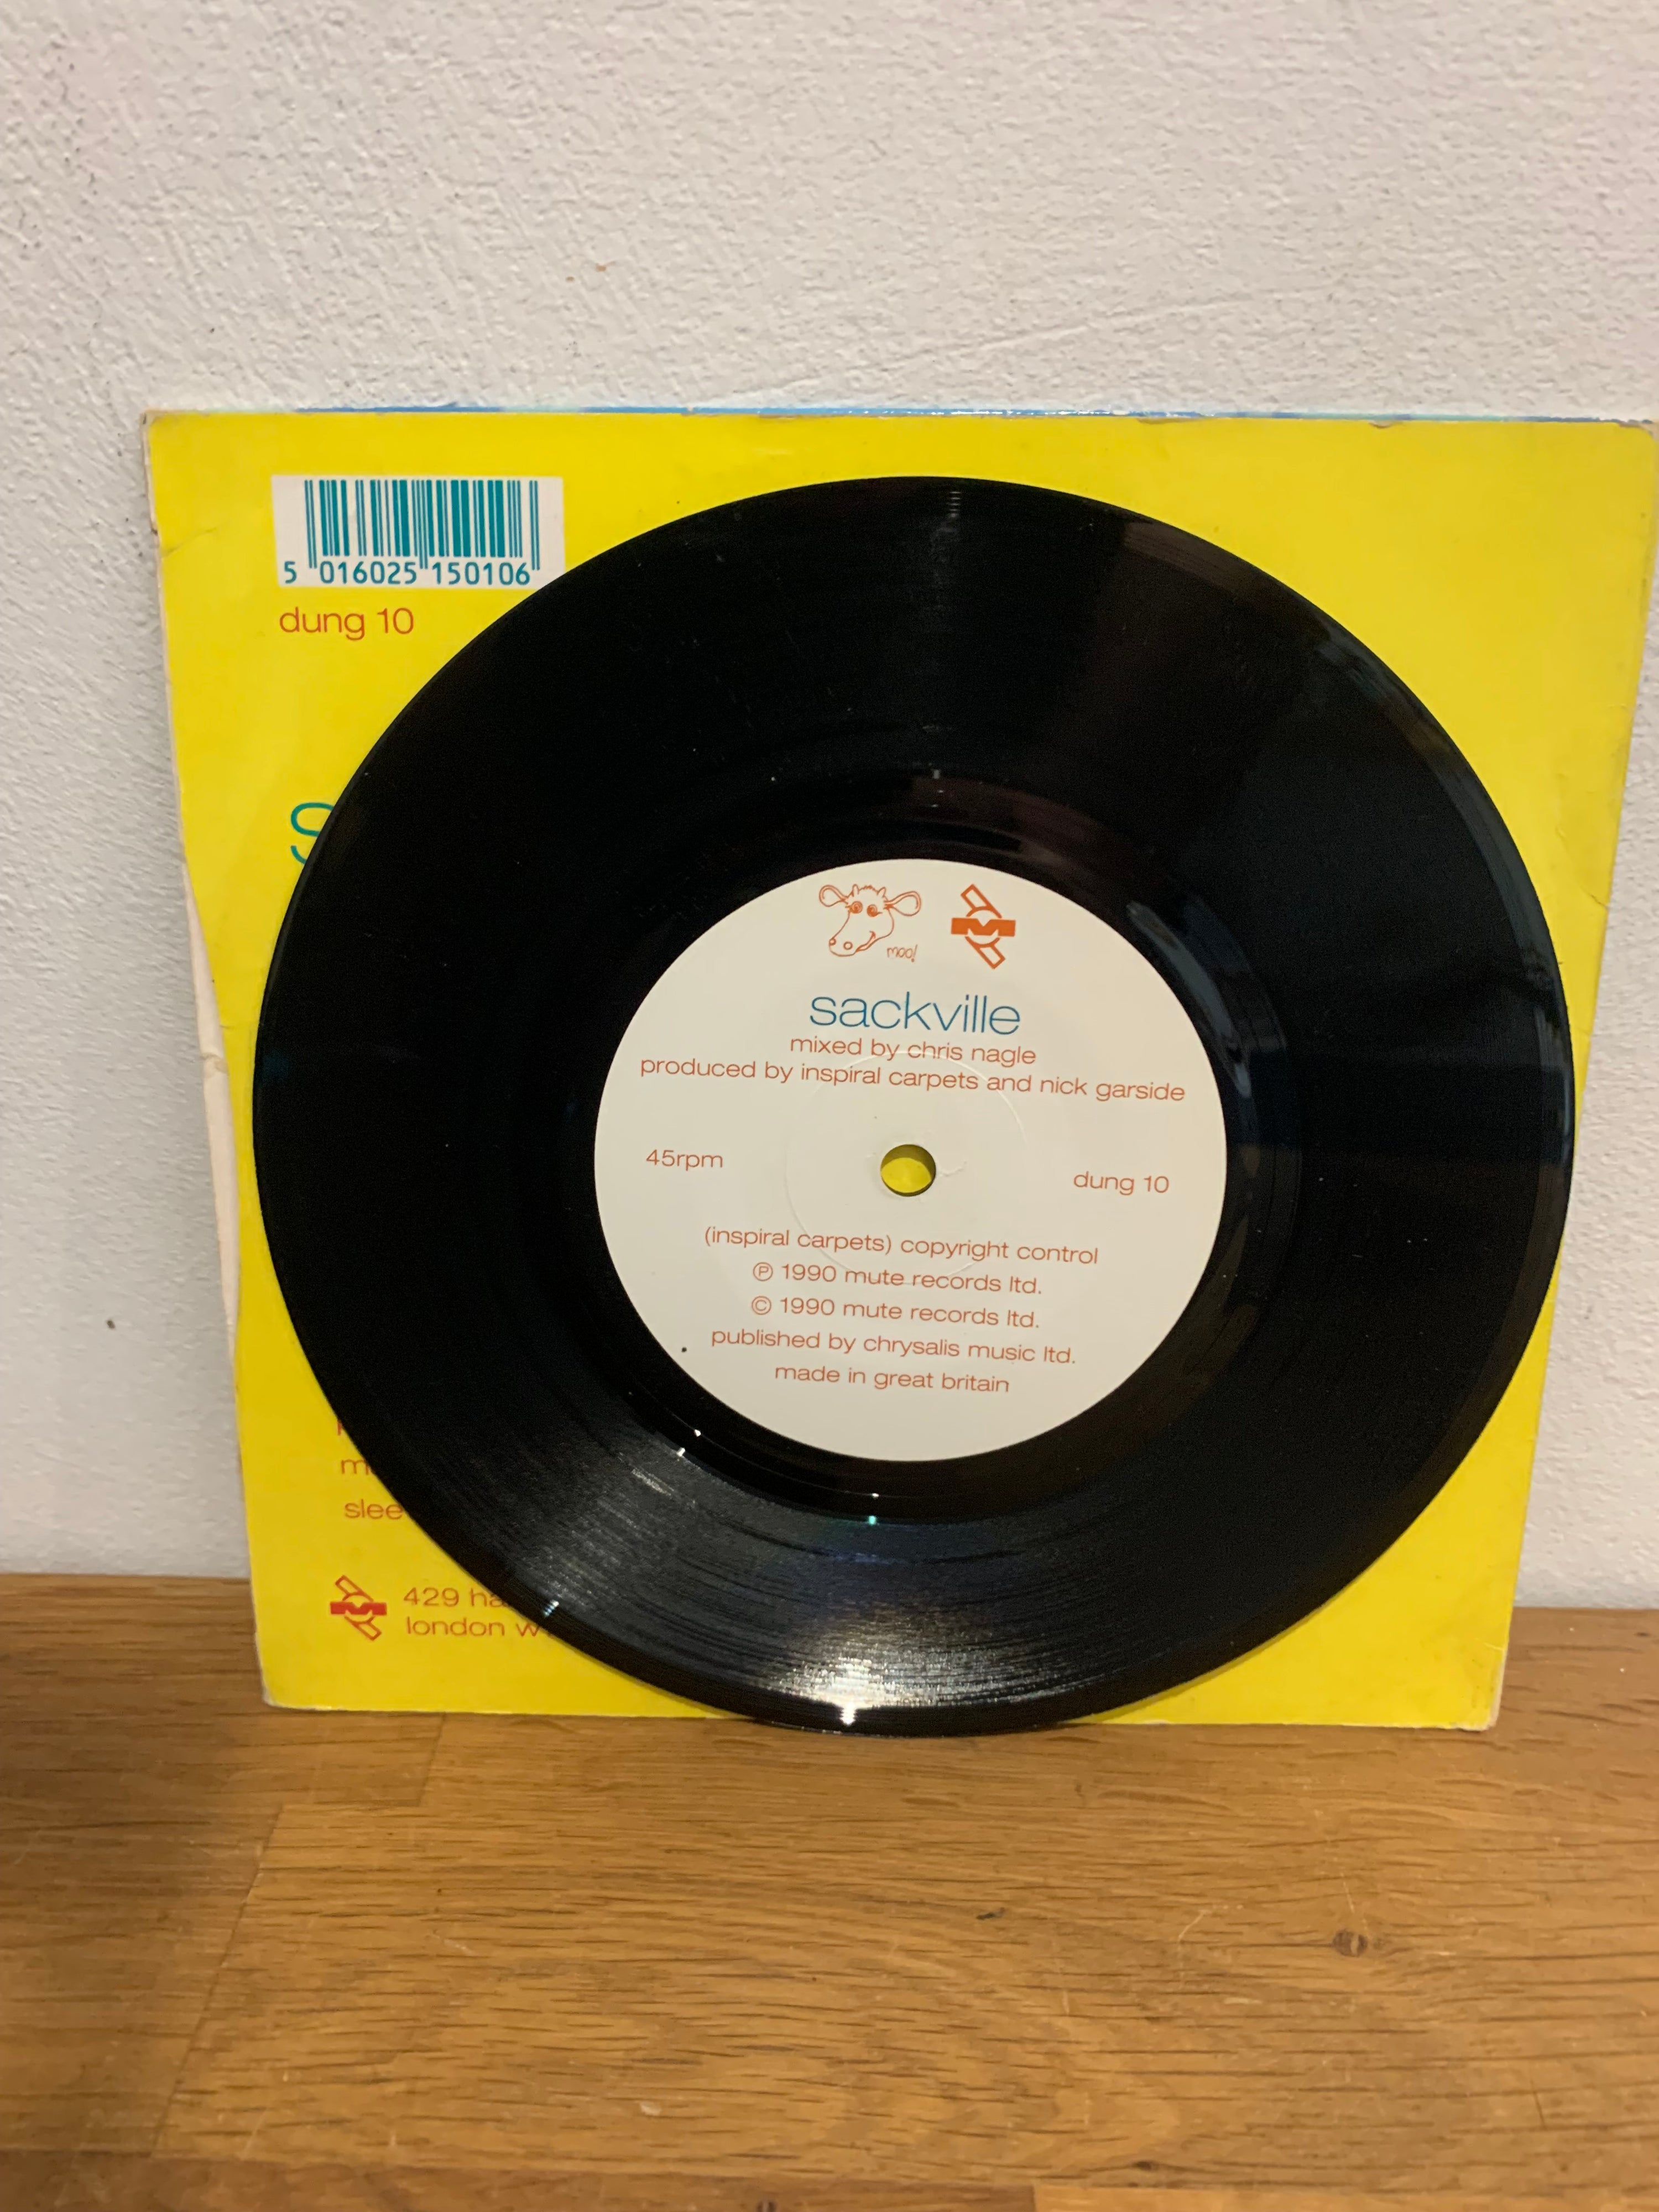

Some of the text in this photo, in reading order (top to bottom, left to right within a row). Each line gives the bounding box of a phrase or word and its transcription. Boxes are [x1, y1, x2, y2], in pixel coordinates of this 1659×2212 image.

[284, 561, 530, 585] 5 016025 150106
[280, 607, 414, 641] dung 10
[810, 992, 1020, 1035] sackville
[791, 1036, 1036, 1068] mixed by chris nagle
[641, 1058, 1185, 1102] produced by inspiral carpets and nick garside
[646, 1150, 723, 1171] 45rpm
[1074, 1171, 1169, 1196] dung 10
[705, 1227, 1098, 1264] (inspiral carpets) copyright control
[782, 1264, 836, 1282] 1990
[846, 1270, 904, 1286] mute
[912, 1275, 1001, 1292] records
[1010, 1276, 1042, 1294] ltd.
[781, 1297, 834, 1316] 1990
[843, 1303, 902, 1319] mute
[911, 1308, 999, 1326] records
[1008, 1310, 1040, 1328] ltd.
[712, 1329, 1076, 1363] published by chrysalis music ltd.
[775, 1366, 1009, 1392] made in great britain
[404, 1588, 459, 1607] 429
[407, 1616, 505, 1636] london
